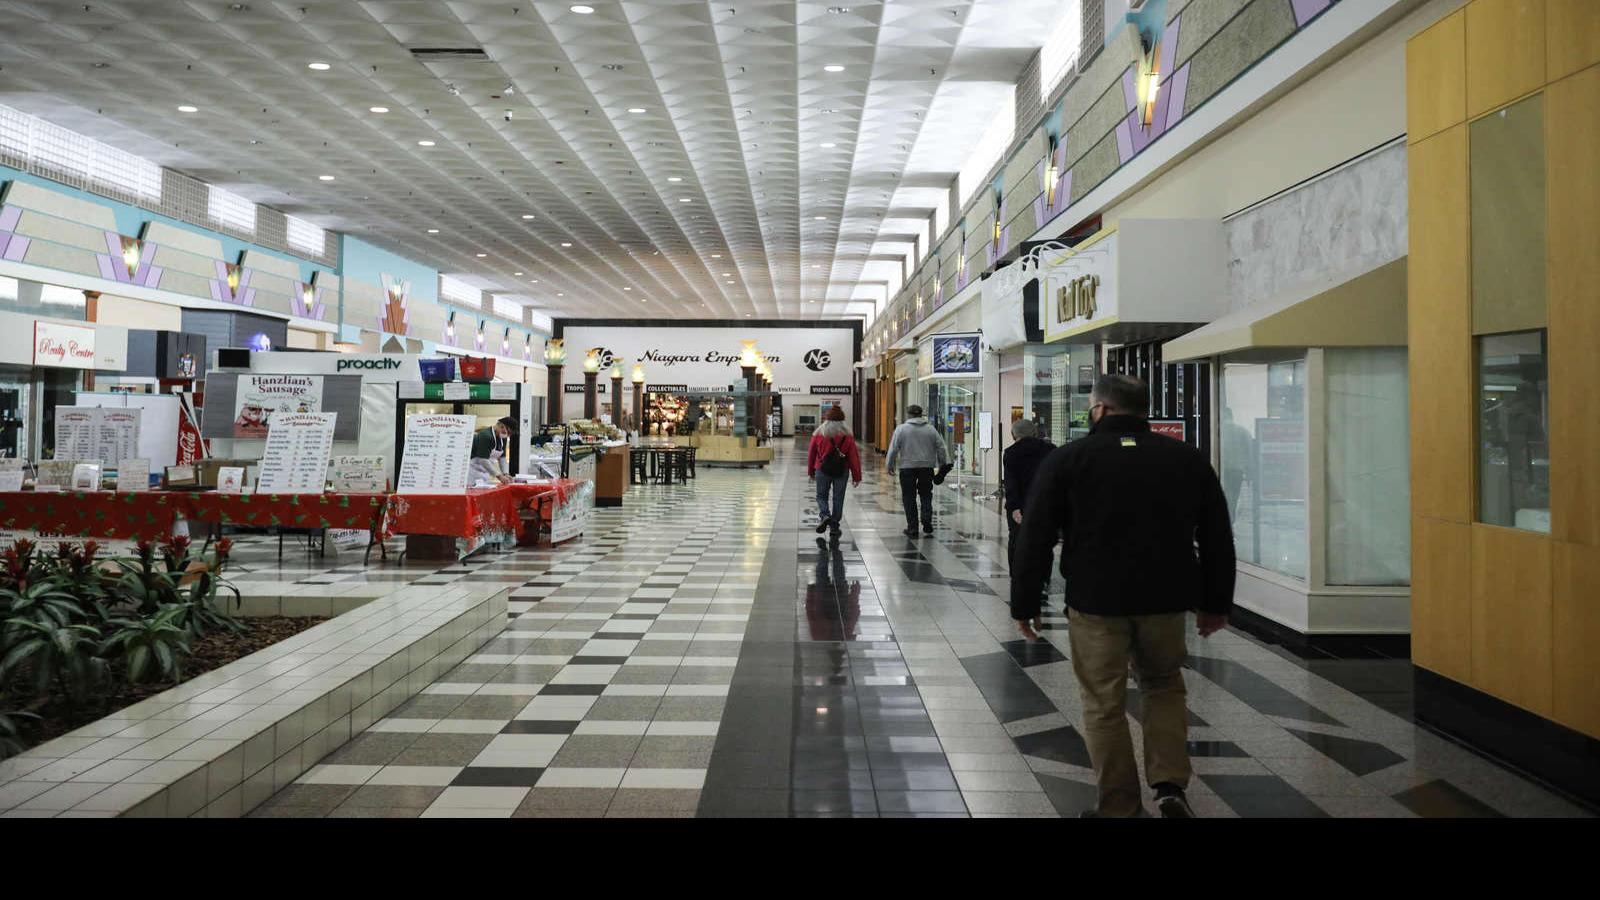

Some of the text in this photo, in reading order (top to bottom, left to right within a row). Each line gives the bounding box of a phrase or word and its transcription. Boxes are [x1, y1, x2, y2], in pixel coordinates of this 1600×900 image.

[637, 349, 700, 366] Niagara
[337, 357, 402, 372] proactiv
[252, 376, 313, 387] Hanzlian's
[258, 385, 307, 396] Sausage
